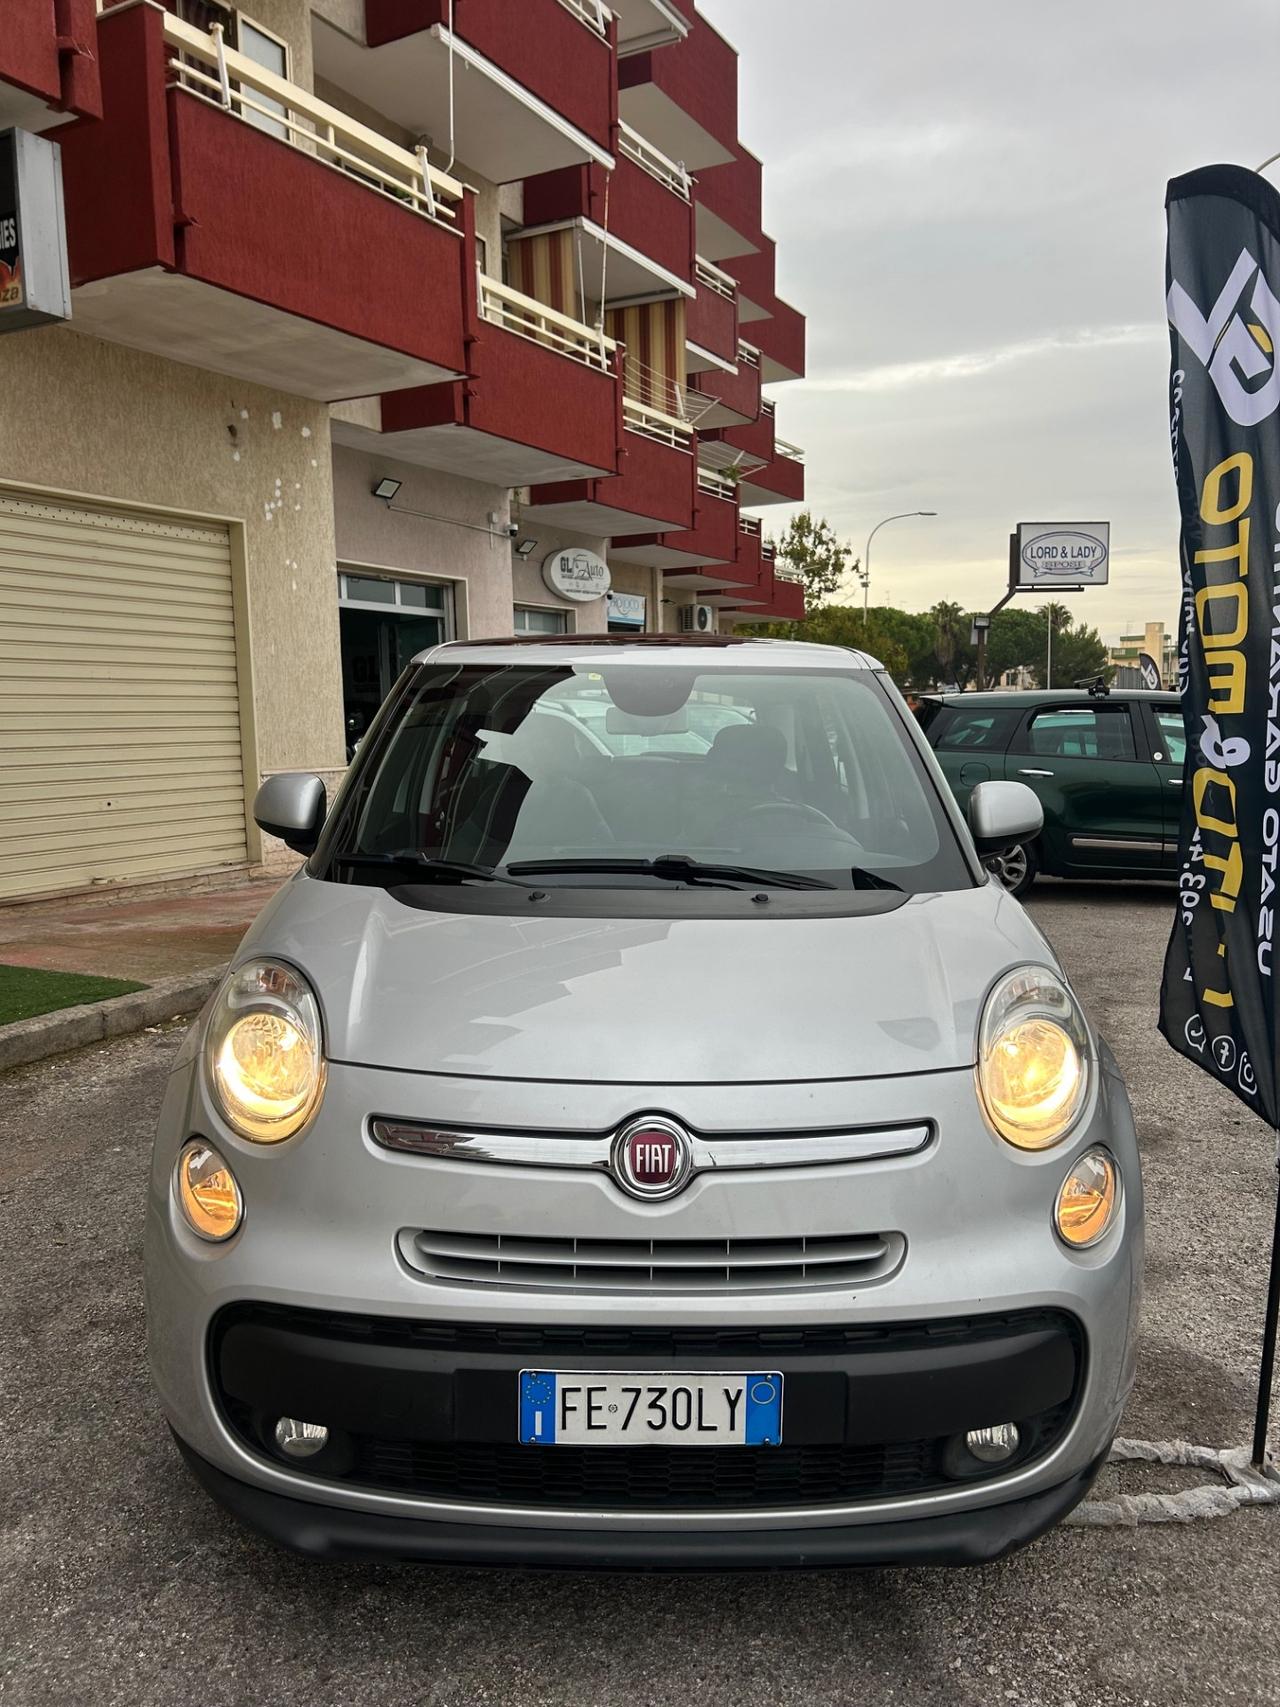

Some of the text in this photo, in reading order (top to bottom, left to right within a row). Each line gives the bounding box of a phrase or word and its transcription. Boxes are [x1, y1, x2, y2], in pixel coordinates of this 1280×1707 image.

[1030, 546, 1097, 559] LORD & LADY
[636, 1144, 672, 1173] FIAT
